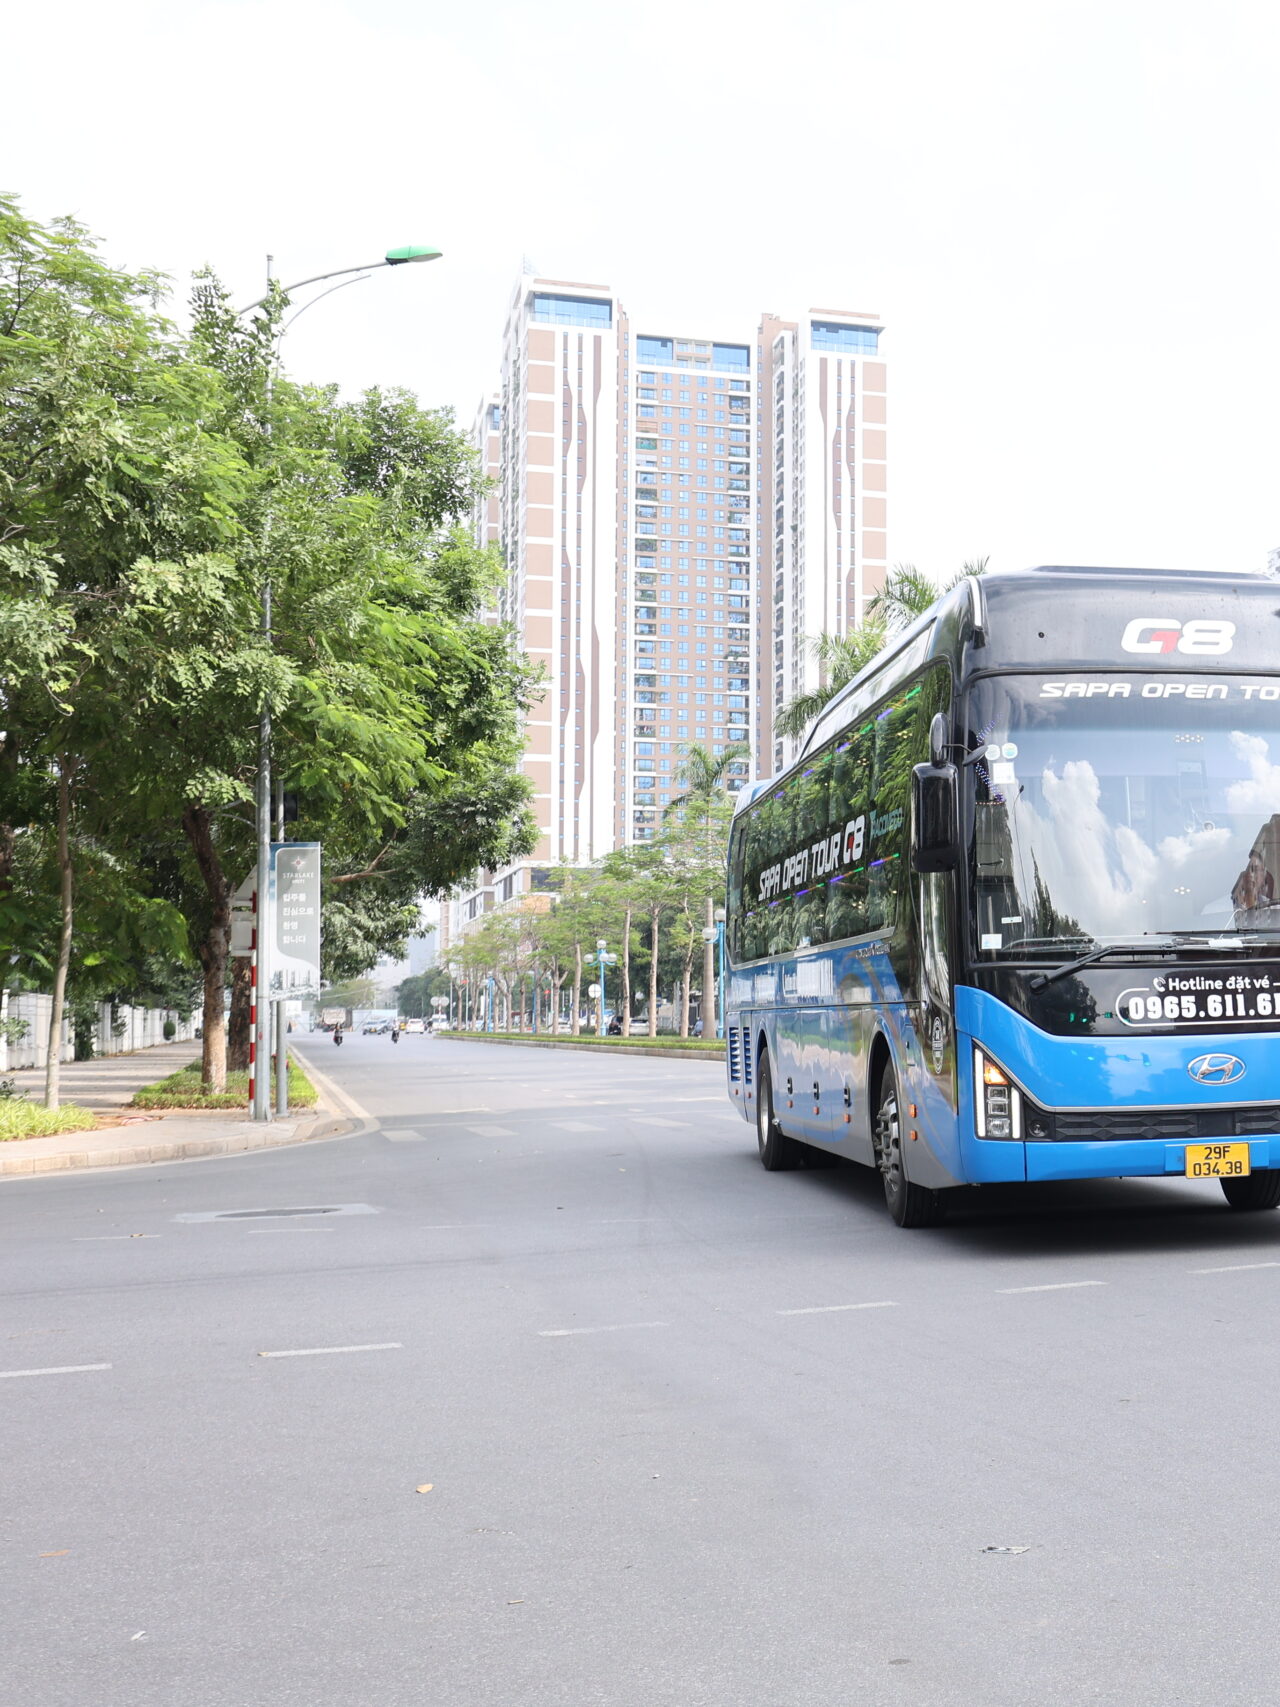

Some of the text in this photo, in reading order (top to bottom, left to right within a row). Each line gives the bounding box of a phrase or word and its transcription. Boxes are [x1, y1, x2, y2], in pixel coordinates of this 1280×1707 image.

[1120, 617, 1236, 655] G8
[1039, 682, 1131, 698] SAPA
[1141, 683, 1229, 700] OPEN
[758, 814, 865, 901] SAPA OPEN TOUR G8
[1168, 975, 1270, 992] Hotline đặt vé
[1204, 1145, 1231, 1160] 29F
[1193, 1160, 1243, 1176] 034.38
